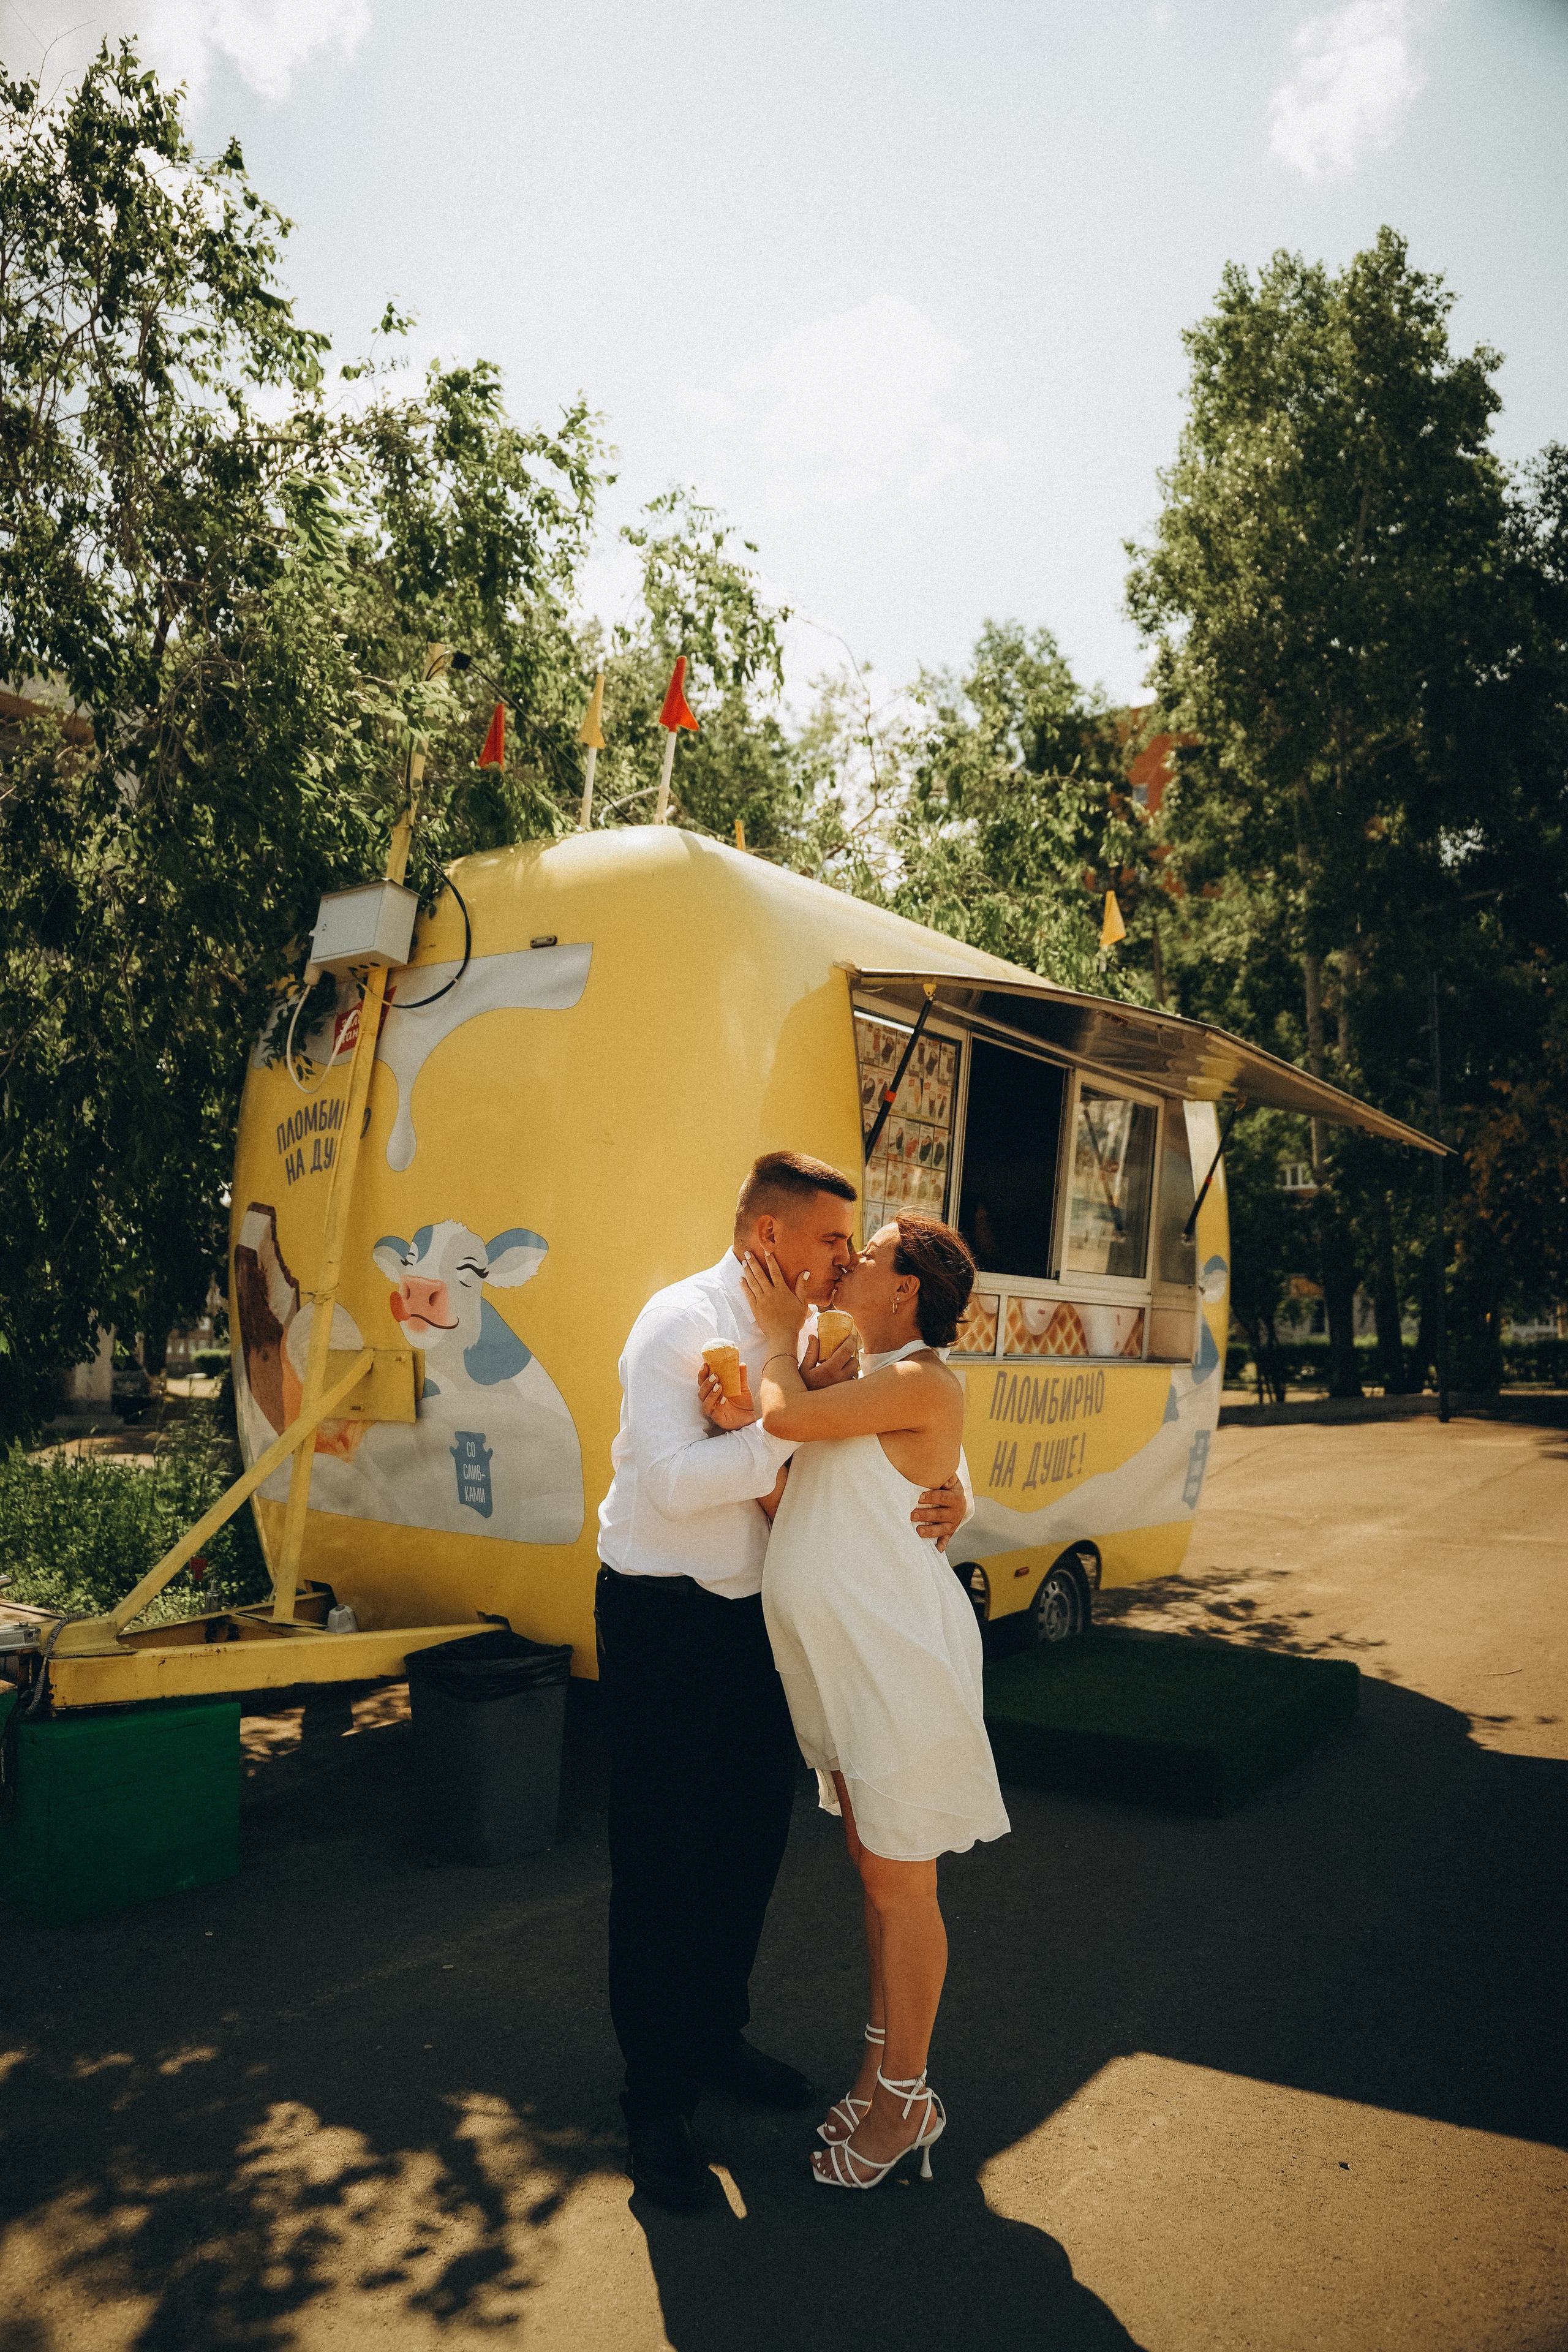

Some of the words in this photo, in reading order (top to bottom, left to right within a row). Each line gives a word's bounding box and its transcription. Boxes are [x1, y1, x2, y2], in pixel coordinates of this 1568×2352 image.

[285, 1148, 305, 1186] НА
[310, 1137, 338, 1174] ДУ
[989, 1369, 1104, 1425] ПЛОМБИРНО
[467, 1441, 475, 1458] СО
[989, 1440, 1017, 1488] НА
[1022, 1432, 1086, 1491] ДУШЕ!
[463, 1463, 486, 1480] СЛИВ-
[464, 1486, 486, 1503] КАМИ
